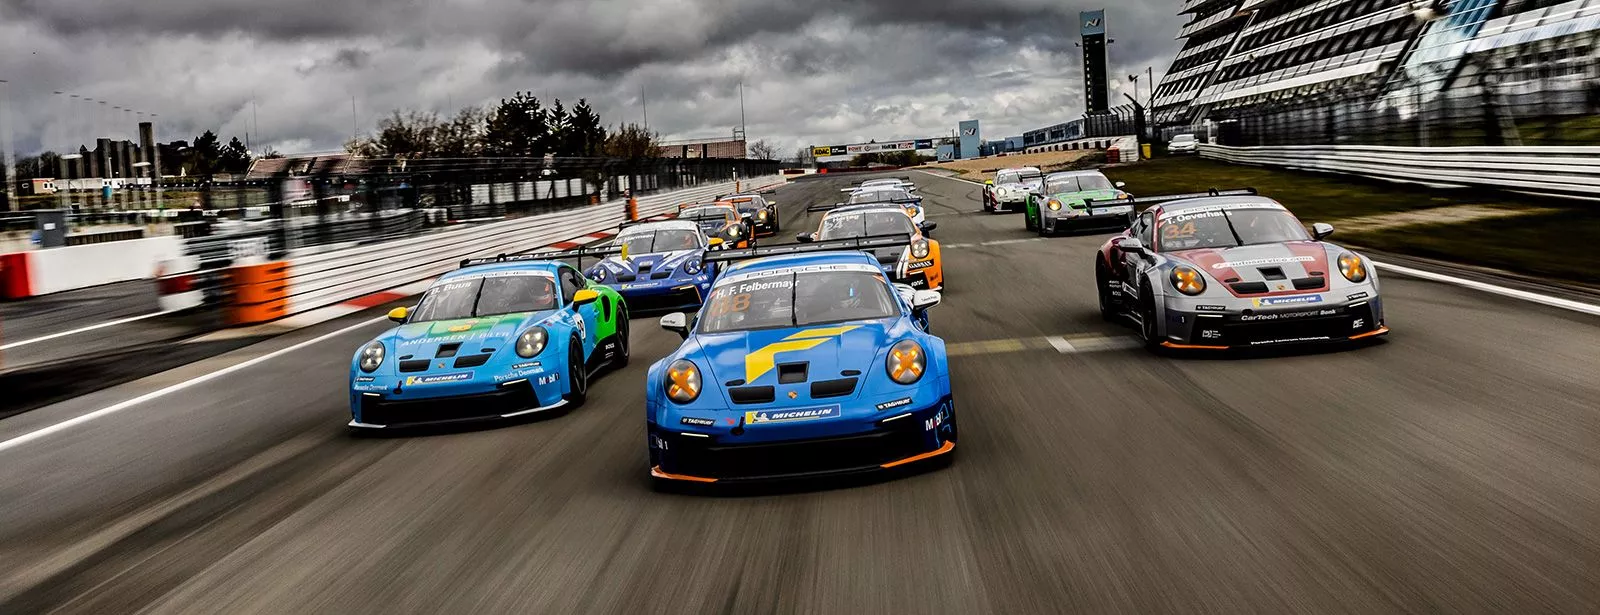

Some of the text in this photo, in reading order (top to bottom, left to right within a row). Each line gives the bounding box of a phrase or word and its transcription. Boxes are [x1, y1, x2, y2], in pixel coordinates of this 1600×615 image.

[1166, 217, 1175, 225] T.
[1165, 221, 1197, 239] 34
[745, 265, 848, 279] PORSCHE
[717, 279, 799, 299] H. F. Felbermayr
[1273, 296, 1317, 304] MICHELIN
[1280, 310, 1319, 319] MOTORSPORT
[401, 333, 467, 346] ANDERSEN
[425, 374, 468, 383] MICHELIN
[494, 367, 545, 381] Porsche Denmark
[538, 375, 555, 386] Mobil
[772, 408, 833, 419] MICHELIN
